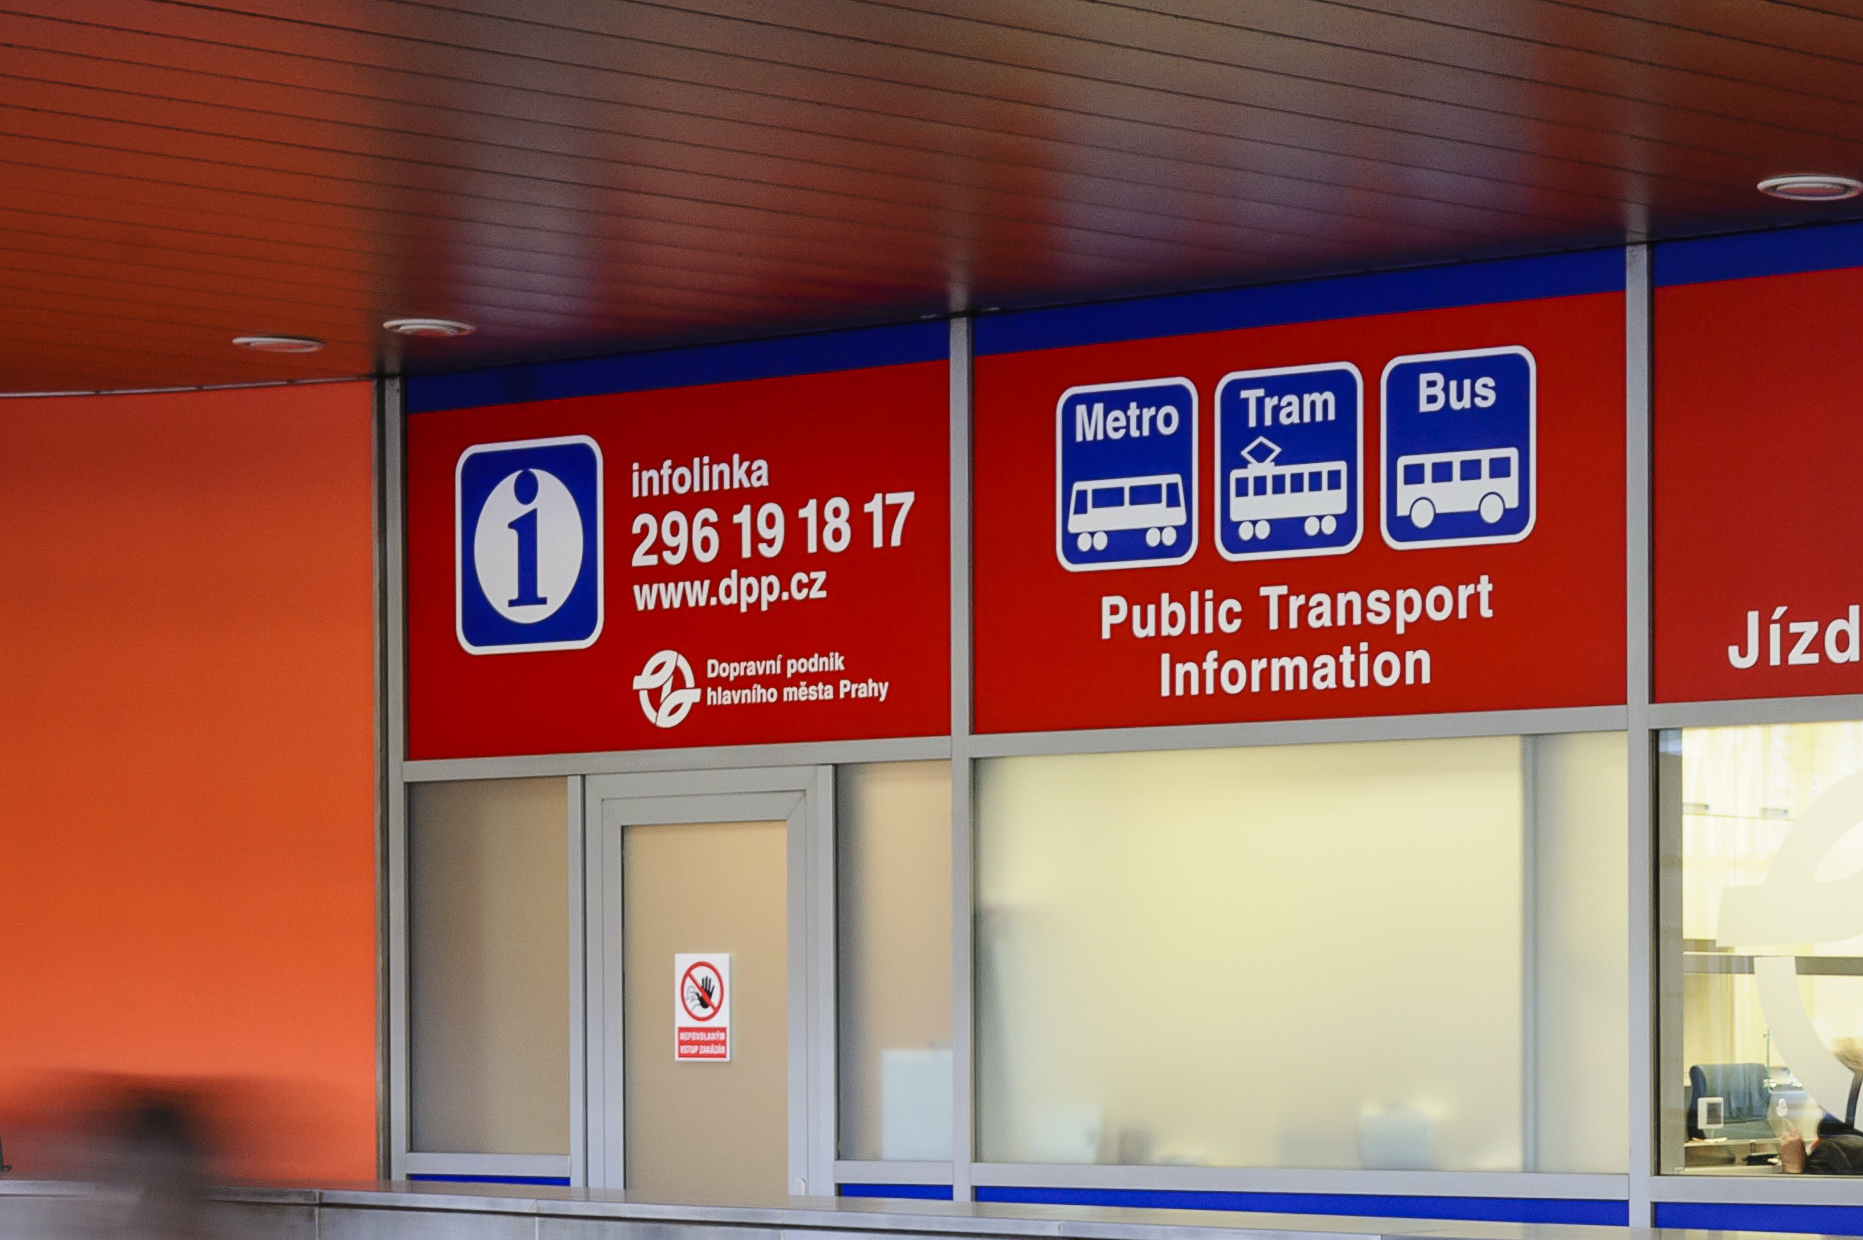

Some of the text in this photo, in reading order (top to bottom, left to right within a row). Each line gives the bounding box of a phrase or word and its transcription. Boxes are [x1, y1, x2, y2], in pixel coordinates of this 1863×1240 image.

[1240, 387, 1336, 428] Tram
[1418, 372, 1497, 412] Bus
[1075, 402, 1180, 442] Metro
[632, 453, 769, 497] infolinka
[631, 491, 915, 567] 296 19 18 17
[634, 567, 827, 612] www.dpp.cz
[1101, 575, 1493, 640] Public Transport
[706, 652, 844, 681] Dopravní podnik
[1160, 642, 1431, 697] Information
[706, 678, 889, 706] hlavního města Prahy
